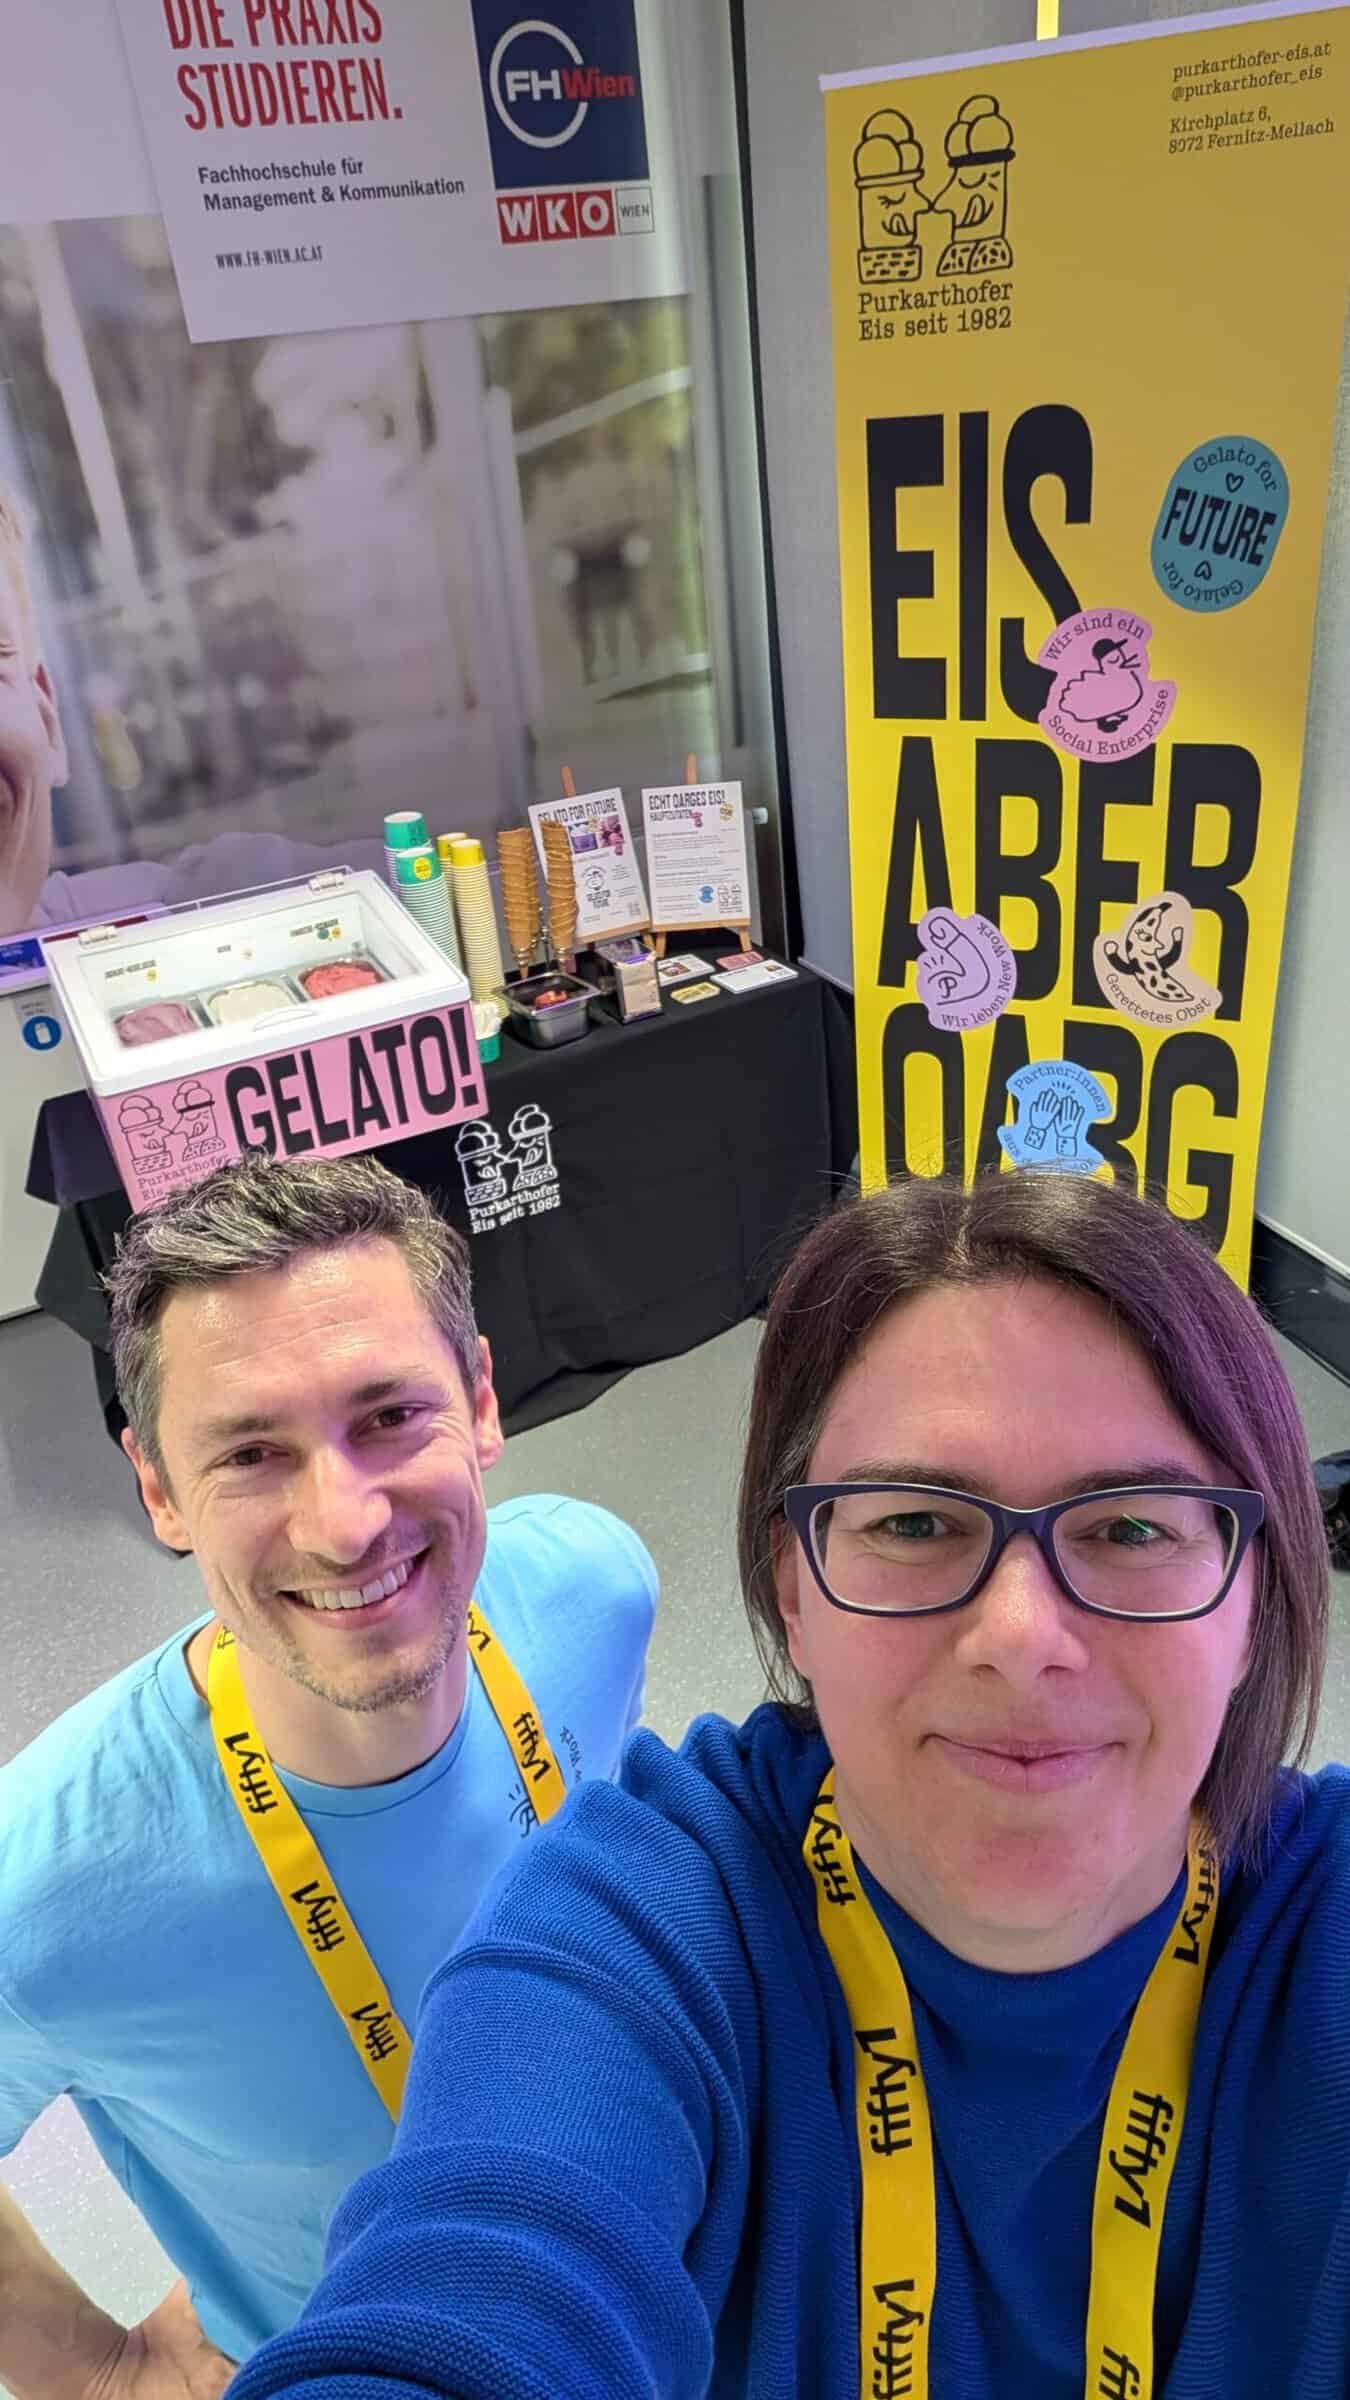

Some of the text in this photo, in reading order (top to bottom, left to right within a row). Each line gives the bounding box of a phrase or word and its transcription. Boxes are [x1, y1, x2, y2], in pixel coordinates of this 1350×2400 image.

[163, 0, 382, 49] DIE PRAXIS
[1171, 65, 1323, 102] @purkarthofer_eis
[1172, 42, 1331, 82] purkarthofer-eis.at
[177, 57, 403, 130] STUDIEREN.
[1170, 111, 1254, 134] Kirchplatz
[198, 156, 363, 184] Fachhochschule für
[204, 178, 465, 212] Management & Kommunikation
[500, 195, 649, 237] WKO WIEN
[216, 246, 323, 269] WWW.FH-WIEN.AC.AT
[858, 280, 1013, 314] Purkarthofer
[859, 305, 1012, 341] Eis seit 1982
[1193, 446, 1277, 491] Gelato for
[1162, 487, 1277, 567] FUTURE
[866, 404, 1093, 723] EIS
[1046, 613, 1145, 661] Wir sind ein
[1049, 689, 1169, 756] Social Enterprise
[877, 735, 1262, 1023] ABER
[942, 922, 1022, 1027] Wir leben New Work
[1106, 973, 1212, 1024] Gerettetes Obst
[225, 1007, 480, 1156] GELATO!
[468, 1183, 560, 1220] Purkarthofer
[472, 1194, 560, 1234] Eis seit 1982
[225, 1732, 278, 1814] fifty1
[291, 1881, 345, 1952] fifty1
[351, 2001, 398, 2061] fifty1
[855, 2028, 916, 2156] fifty1
[1108, 2090, 1173, 2229] fifty1
